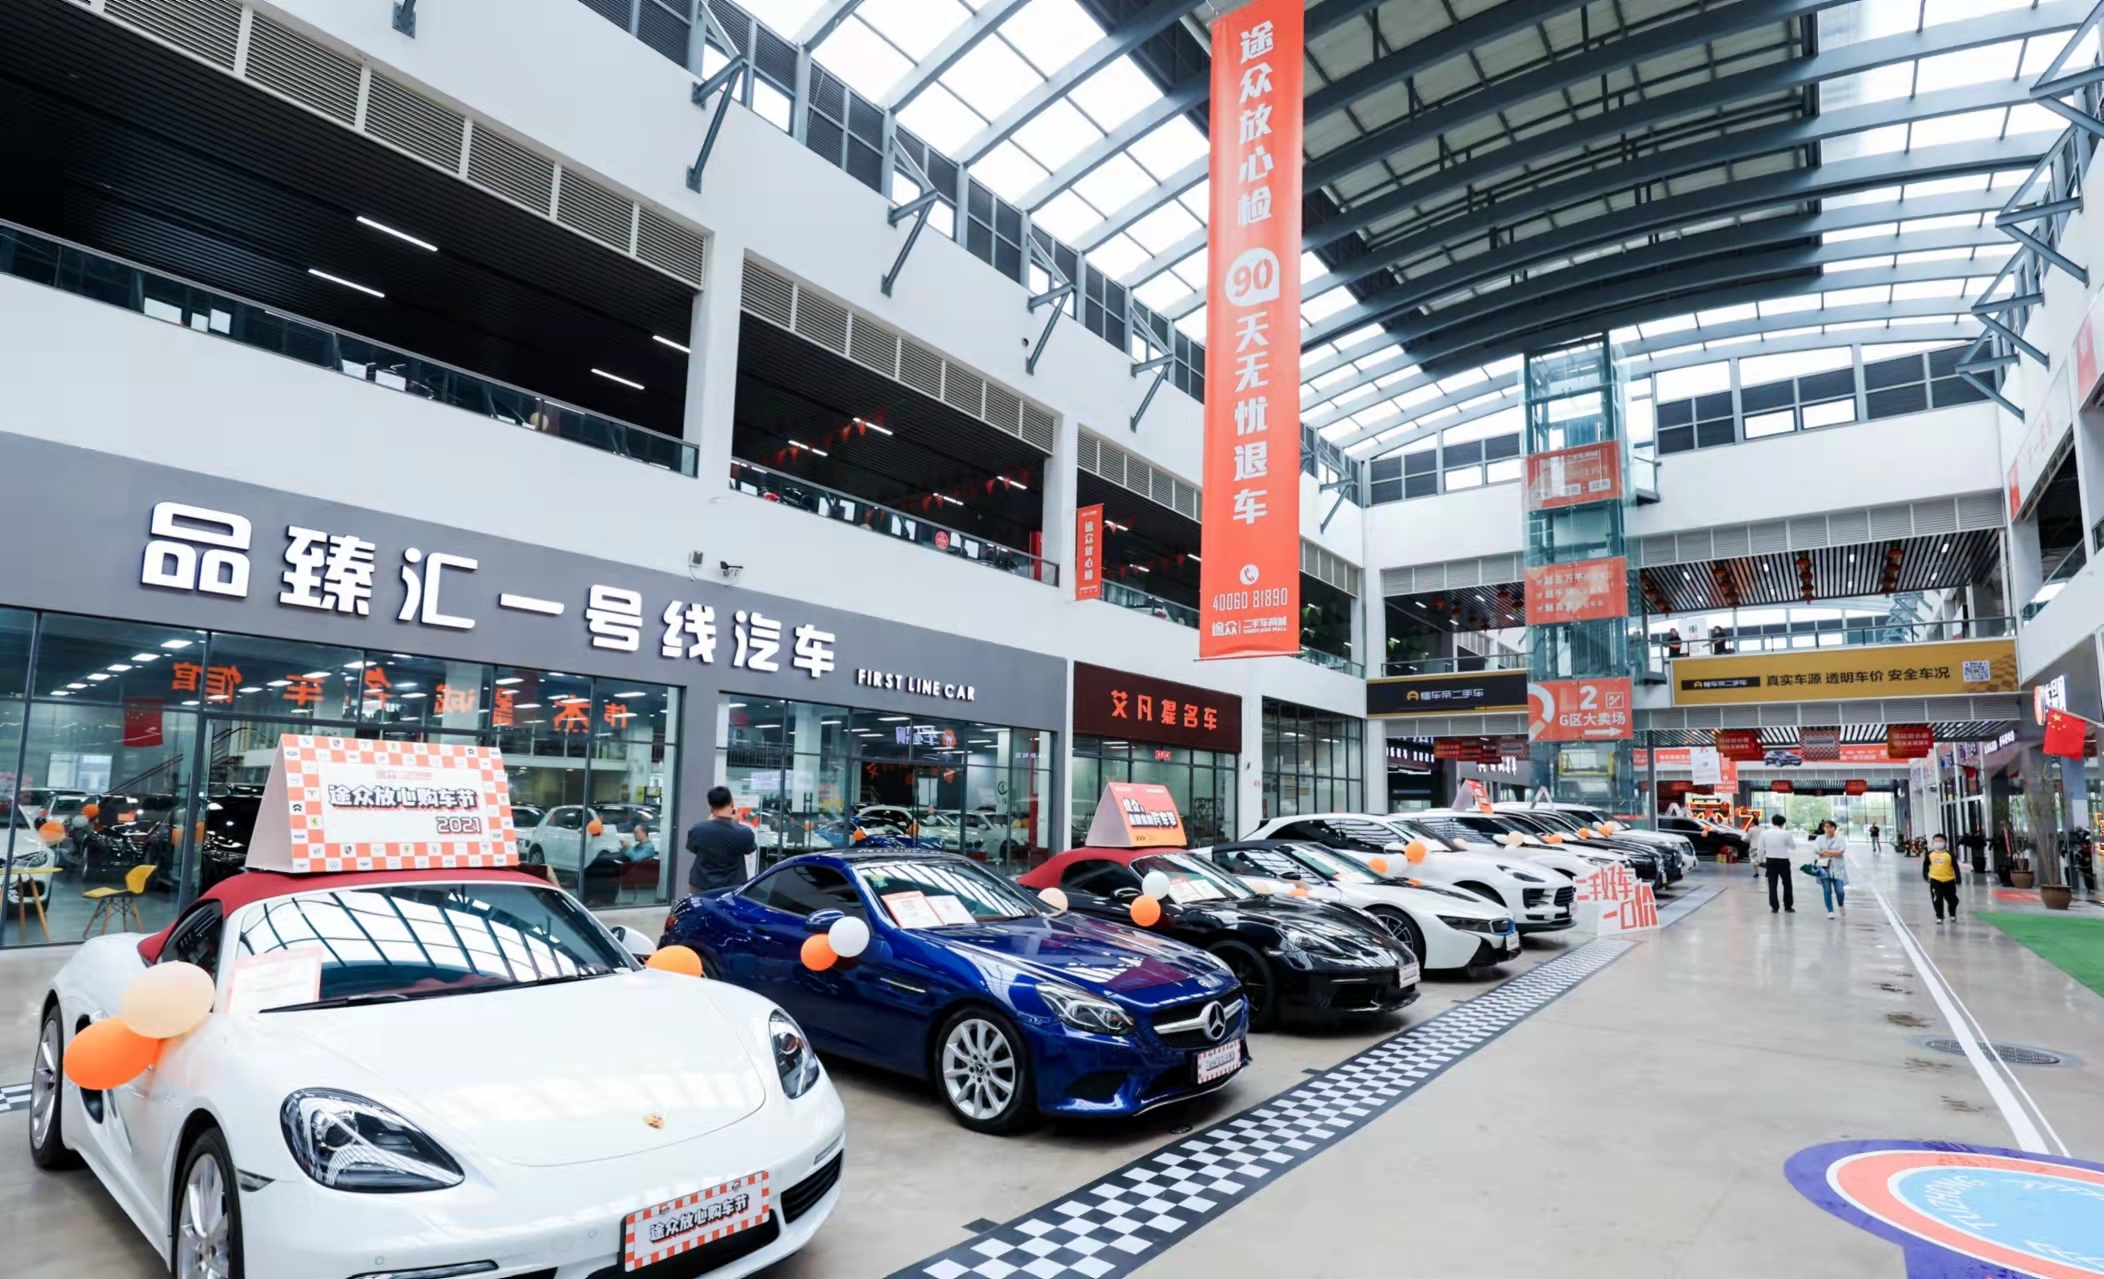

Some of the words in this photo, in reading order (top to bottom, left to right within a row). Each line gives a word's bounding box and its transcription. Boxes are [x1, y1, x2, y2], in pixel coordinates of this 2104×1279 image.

[1239, 20, 1274, 226] 途众放心检
[141, 501, 836, 679] 品臻汇一号线汽车
[1213, 591, 1248, 611] 40060
[1253, 587, 1288, 608] 81890
[857, 668, 902, 690] FIRST
[908, 677, 940, 696] LINE
[944, 684, 975, 700] CAR
[1766, 672, 1821, 686] 真实车源
[1825, 669, 1885, 685] 透明车价
[1887, 666, 1951, 681] 安全车况
[1580, 685, 1598, 710] 2
[1559, 711, 1626, 727] G区大卖场
[327, 783, 479, 811] 途众放心购车节
[436, 816, 482, 834] 2021
[1575, 865, 1634, 901] 二手好车
[1603, 883, 1658, 929] 一口价
[650, 1193, 750, 1244] 途众放心购车节
